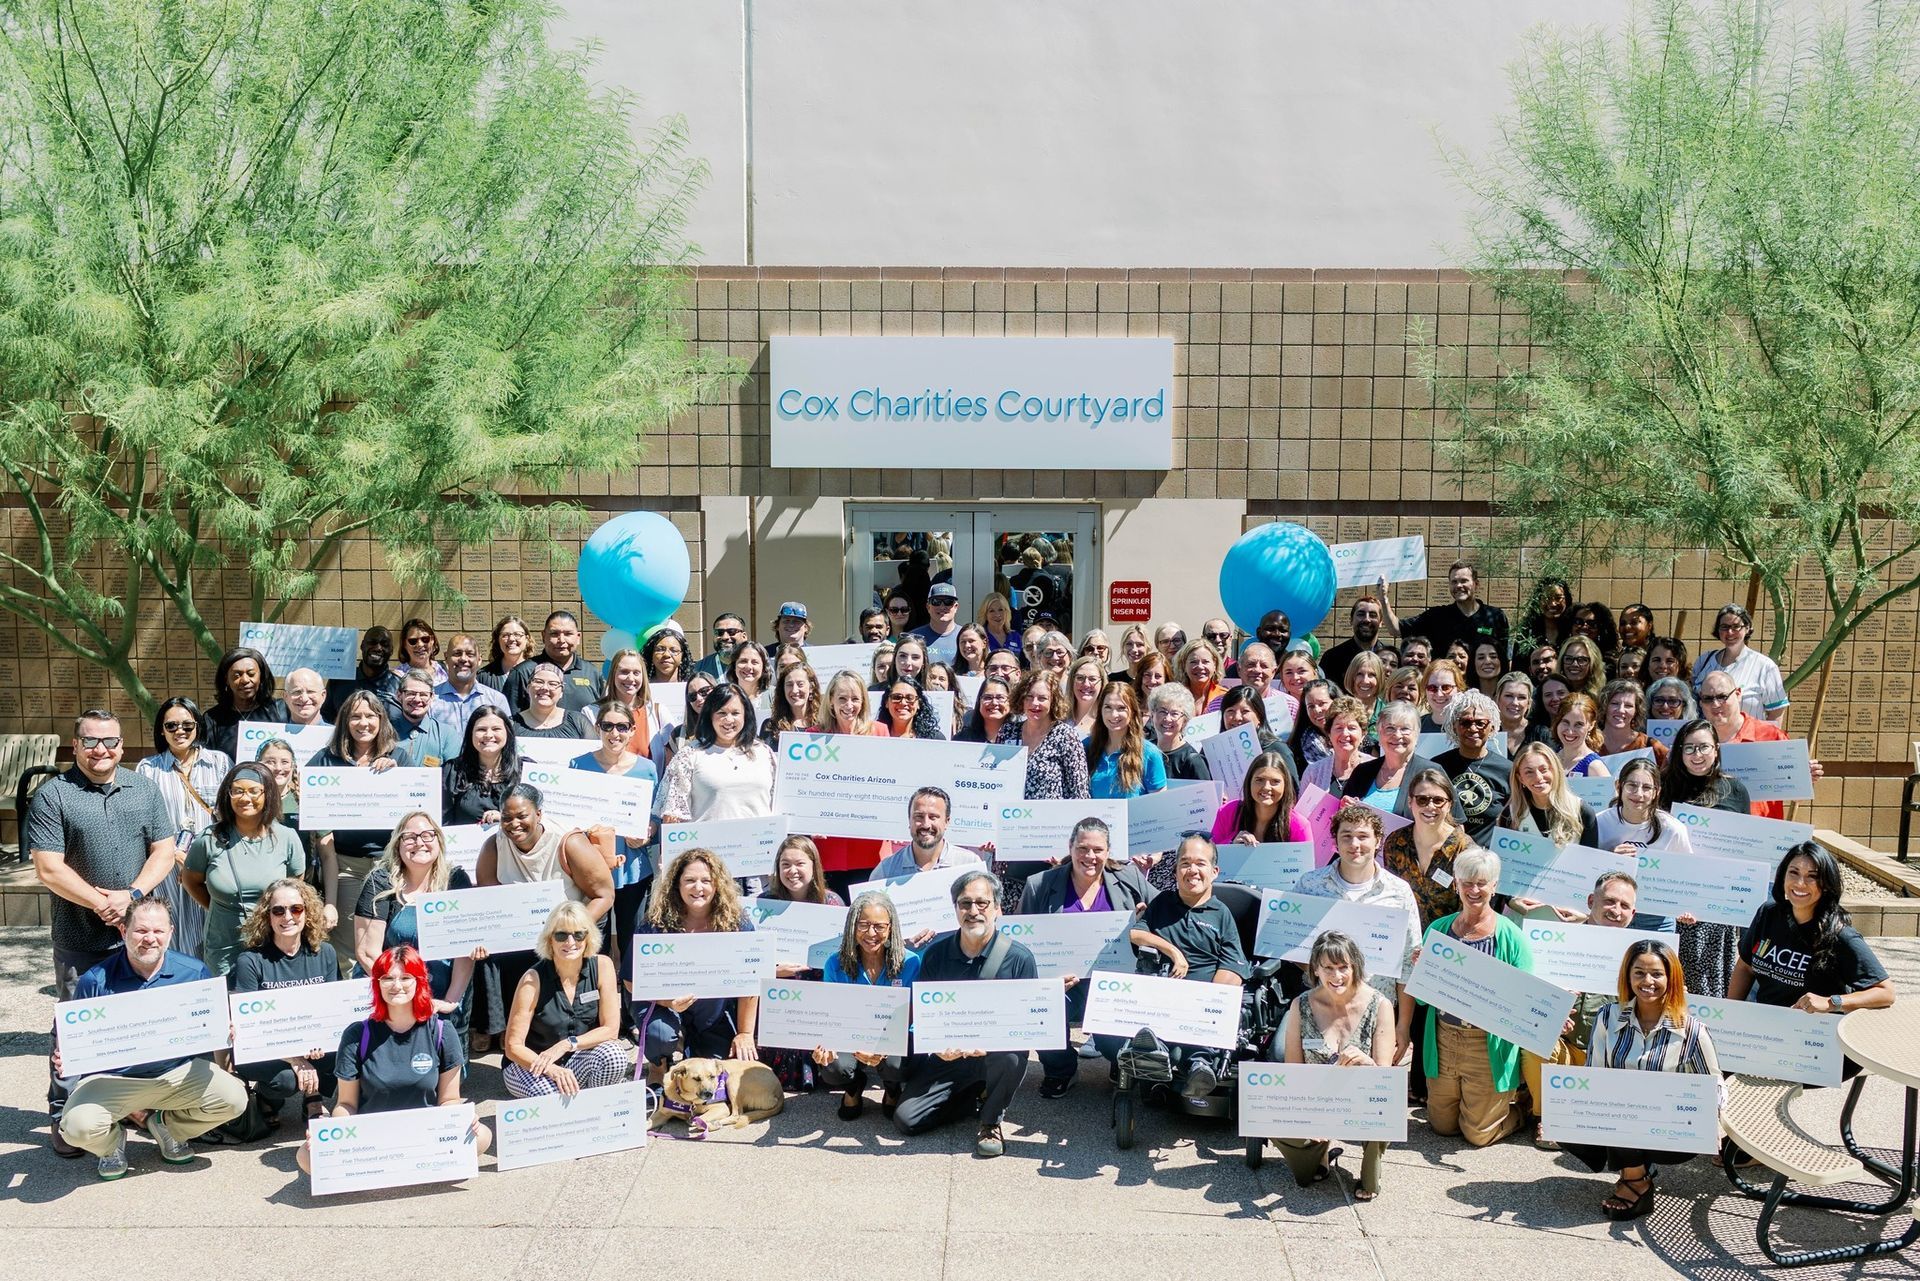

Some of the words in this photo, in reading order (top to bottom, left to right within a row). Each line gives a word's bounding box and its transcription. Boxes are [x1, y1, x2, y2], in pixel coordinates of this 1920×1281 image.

[779, 388, 839, 417] Cox
[850, 387, 987, 417] Charities
[997, 388, 1164, 424] Courtyard
[1336, 548, 1357, 558] COX
[246, 630, 274, 640] COX
[245, 729, 277, 740] COX
[1239, 731, 1254, 759] COX
[788, 743, 840, 762] COX
[307, 775, 341, 786] COX
[528, 771, 559, 785] COX
[832, 774, 865, 782] Charities
[867, 776, 896, 784] Arizona
[1002, 808, 1032, 819] COX
[954, 818, 992, 827] Charities
[1677, 813, 1711, 828] COX
[668, 831, 698, 842] COX
[1498, 838, 1532, 854] COX
[424, 900, 459, 914] COX
[1268, 899, 1302, 913] COX
[1001, 924, 1034, 935] COX
[1530, 930, 1565, 942] COX
[641, 944, 675, 954] COX
[1432, 943, 1467, 966] COX
[1763, 945, 1812, 971] ACEE
[1775, 967, 1804, 978] COUNCIL
[261, 976, 325, 988] CHANGEMAKER
[1098, 980, 1133, 992] COX
[1443, 968, 1460, 980] Arizona
[1461, 976, 1480, 990] Helping
[1480, 985, 1496, 995] Hands
[1772, 974, 1804, 987] EDUCATION
[768, 988, 802, 1001] COX
[921, 992, 956, 1004] COX
[191, 1009, 210, 1017] $5,000
[239, 1000, 275, 1014] COX
[1531, 1007, 1548, 1018] $7,500
[1687, 1004, 1724, 1020] COX
[65, 1007, 106, 1024] COX
[88, 1026, 115, 1035] Southwest
[149, 1016, 177, 1026] Foundation
[104, 1035, 129, 1043] Thousand
[186, 1033, 211, 1041] Charities
[1804, 1040, 1824, 1048] $5,000
[1778, 1059, 1793, 1067] COX
[1795, 1062, 1821, 1071] Charities
[1248, 1073, 1286, 1086] COX
[1550, 1075, 1590, 1090] COX
[504, 1107, 540, 1123] COX
[318, 1126, 357, 1142] COX
